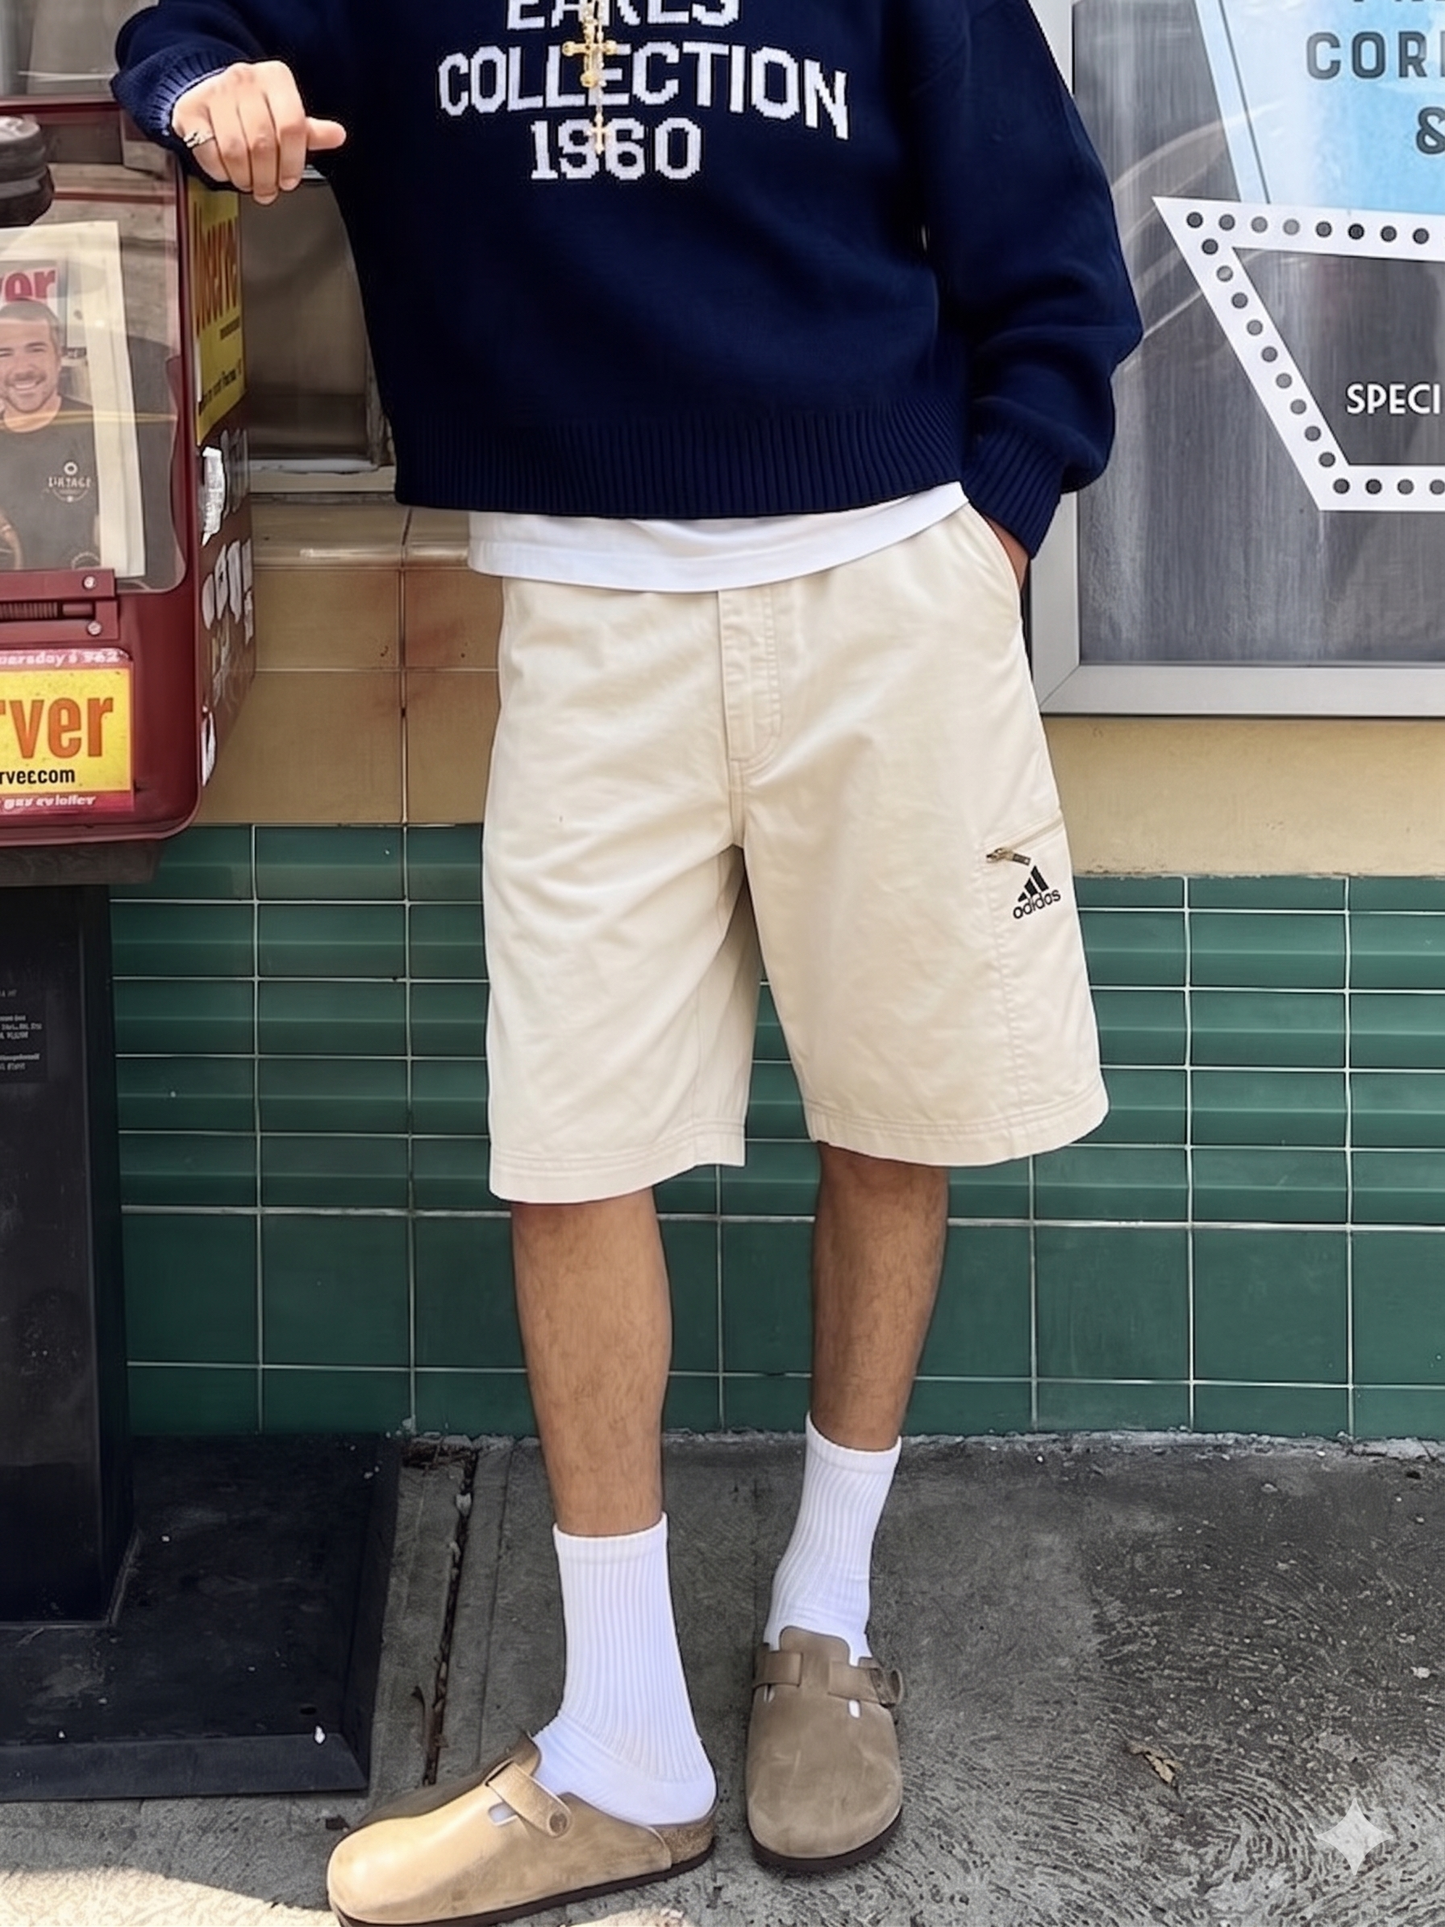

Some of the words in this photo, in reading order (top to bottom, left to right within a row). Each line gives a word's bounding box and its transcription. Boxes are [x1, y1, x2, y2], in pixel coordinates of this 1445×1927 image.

[1306, 30, 1445, 80] COR
[438, 41, 849, 140] COLLECTION
[530, 117, 702, 181] 1960
[1415, 106, 1445, 155] &
[0, 269, 56, 303] er
[1345, 383, 1441, 415] SPECI
[0, 697, 114, 760] ver
[1012, 888, 1062, 920] adidas
